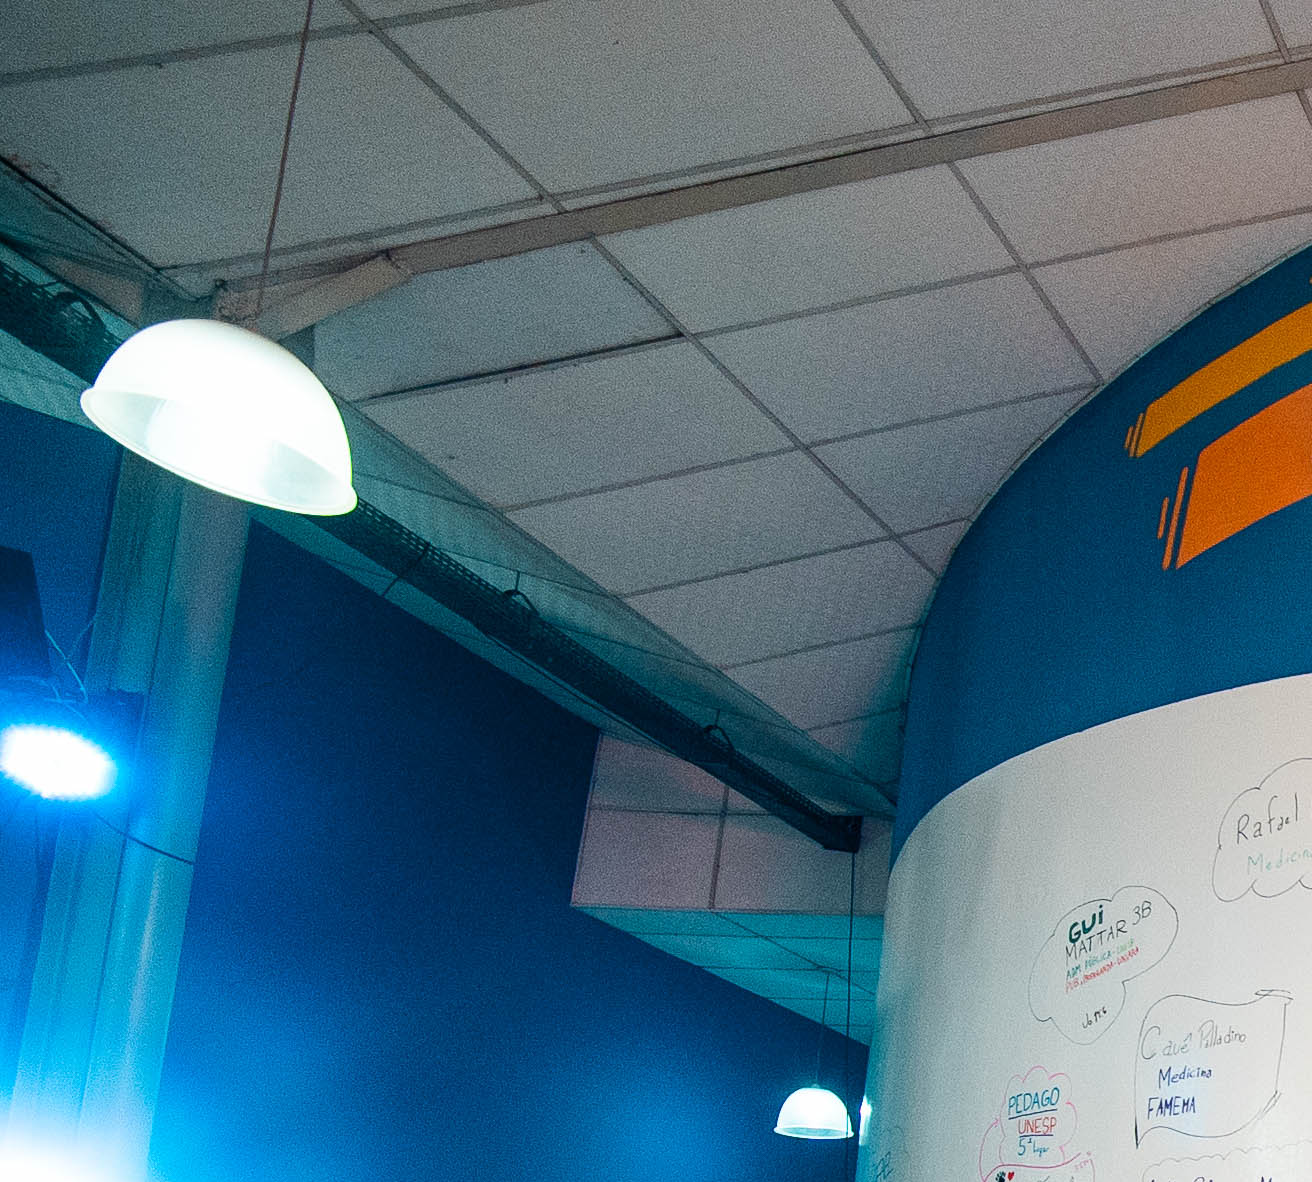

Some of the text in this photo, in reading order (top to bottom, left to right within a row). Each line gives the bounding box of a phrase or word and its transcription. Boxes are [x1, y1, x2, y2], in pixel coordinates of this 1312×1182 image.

[1066, 920, 1128, 962] MATTAR
[1158, 1065, 1213, 1089] Medicina
[1008, 1087, 1060, 1115] PEDAGO
